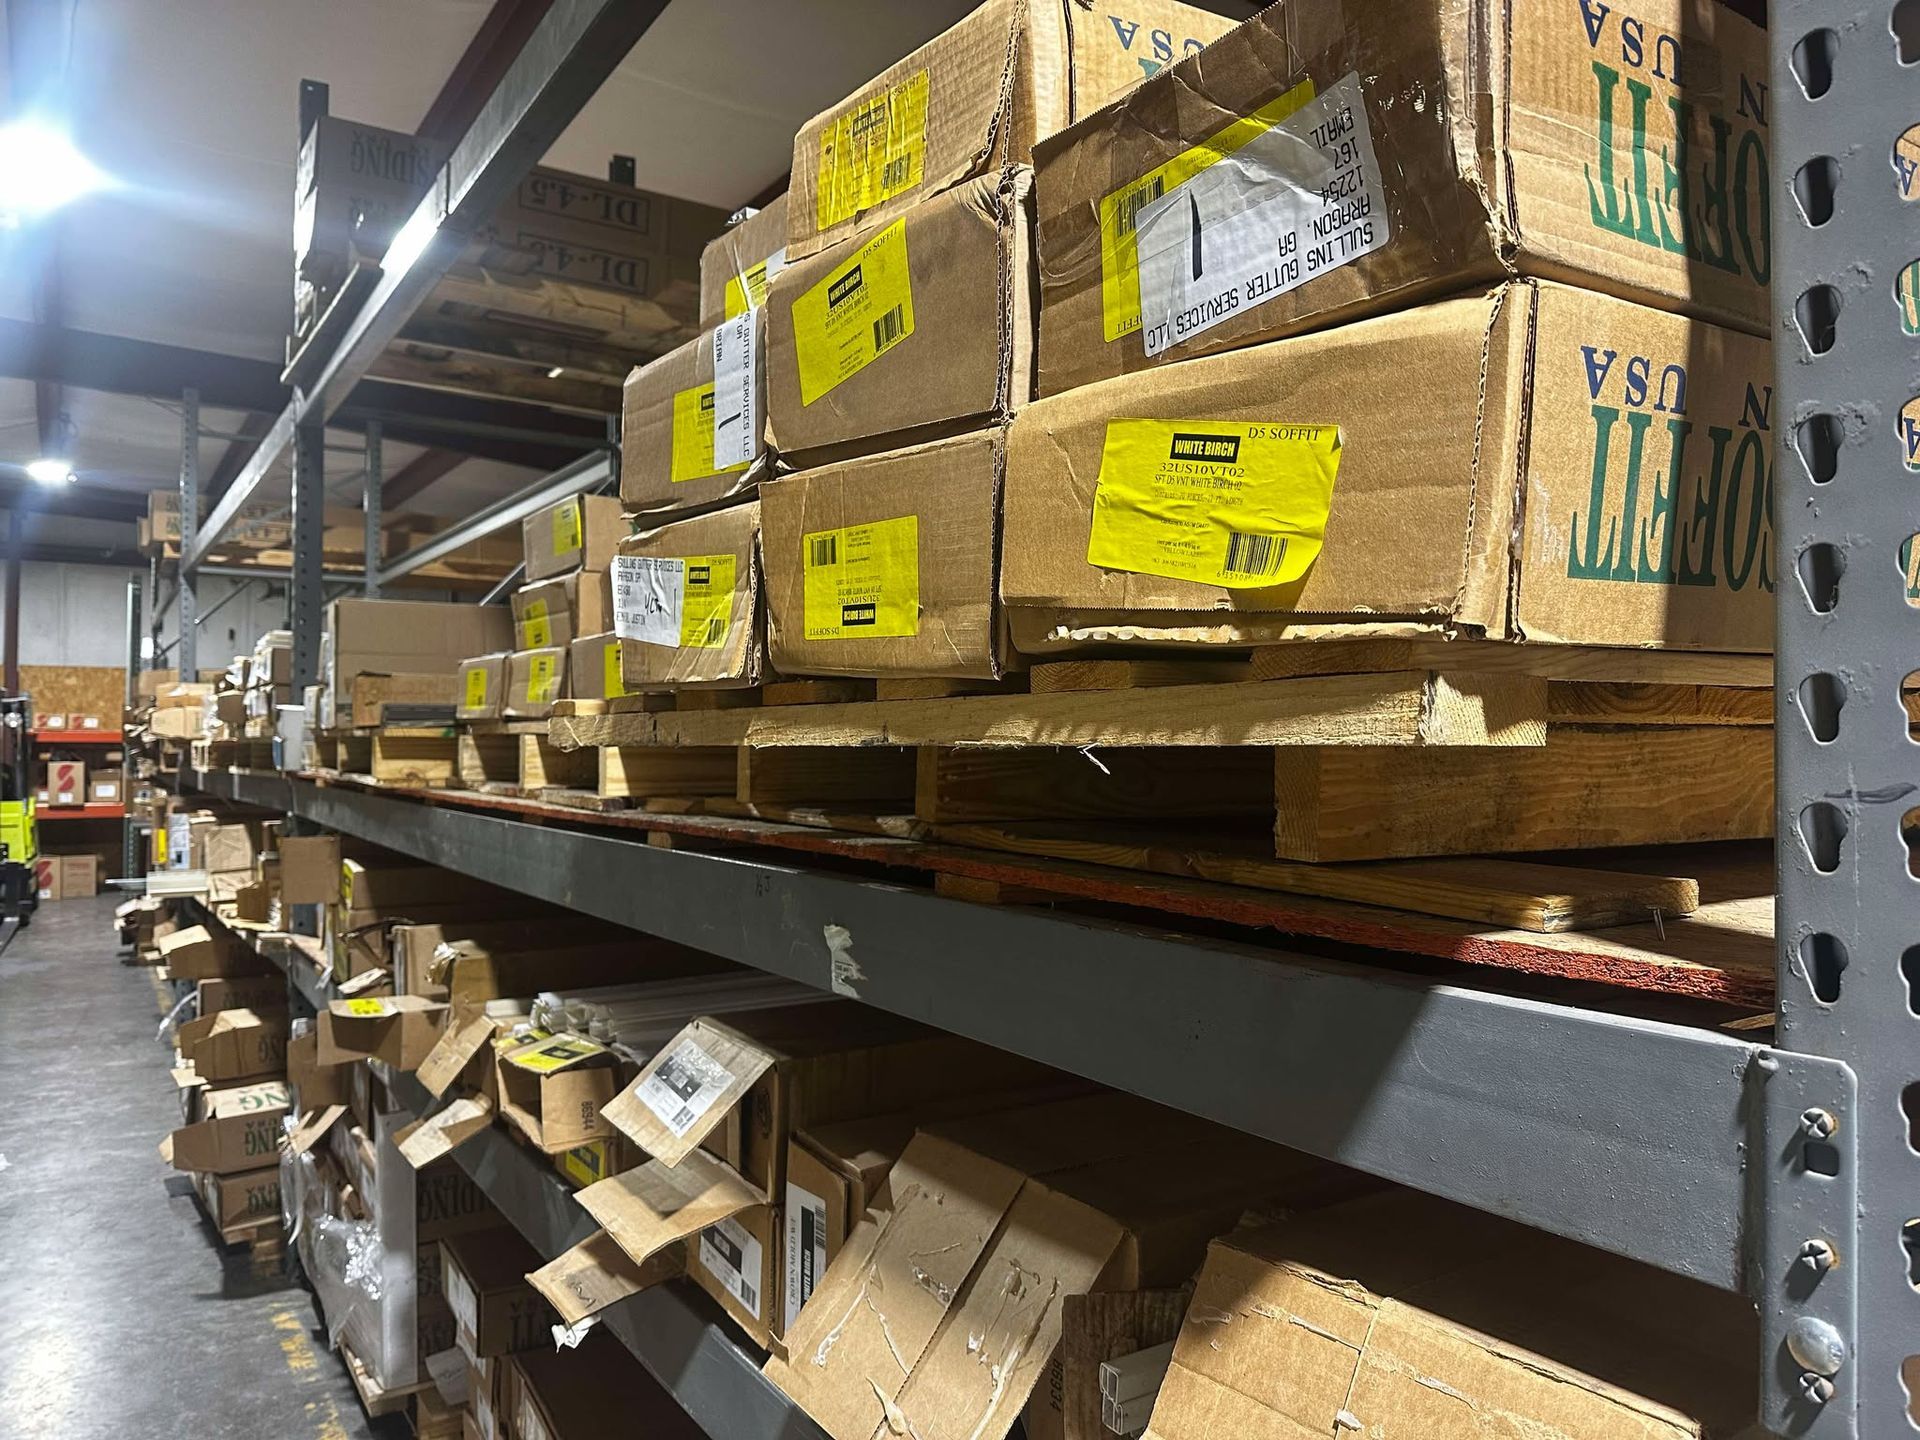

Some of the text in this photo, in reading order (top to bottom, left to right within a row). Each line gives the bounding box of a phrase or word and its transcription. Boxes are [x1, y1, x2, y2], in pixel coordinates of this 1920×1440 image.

[1578, 0, 1687, 88] USA
[1310, 106, 1355, 150] EMAIL
[1334, 136, 1360, 171] 167
[1320, 165, 1364, 207] 12254
[1583, 60, 1771, 287] OFFIT
[531, 179, 639, 227] DL-4.5
[873, 228, 898, 252] SOFFIT
[1278, 232, 1297, 258] GA
[845, 270, 861, 290] BIRCH
[1148, 221, 1374, 349] SULLINS GUTTER SERVICES LLC
[743, 327, 751, 370] GUTTER
[1580, 345, 1688, 416] USA
[743, 375, 751, 431] SERVICES
[743, 436, 751, 457] LLC
[1174, 439, 1236, 457] WHITE BIRCH
[1248, 426, 1322, 442] D5 SOFFIT
[1159, 462, 1245, 478] 32US10VT02
[1176, 476, 1191, 487] VNT
[1191, 477, 1213, 489] WHITE
[1213, 477, 1234, 491] BIRCH
